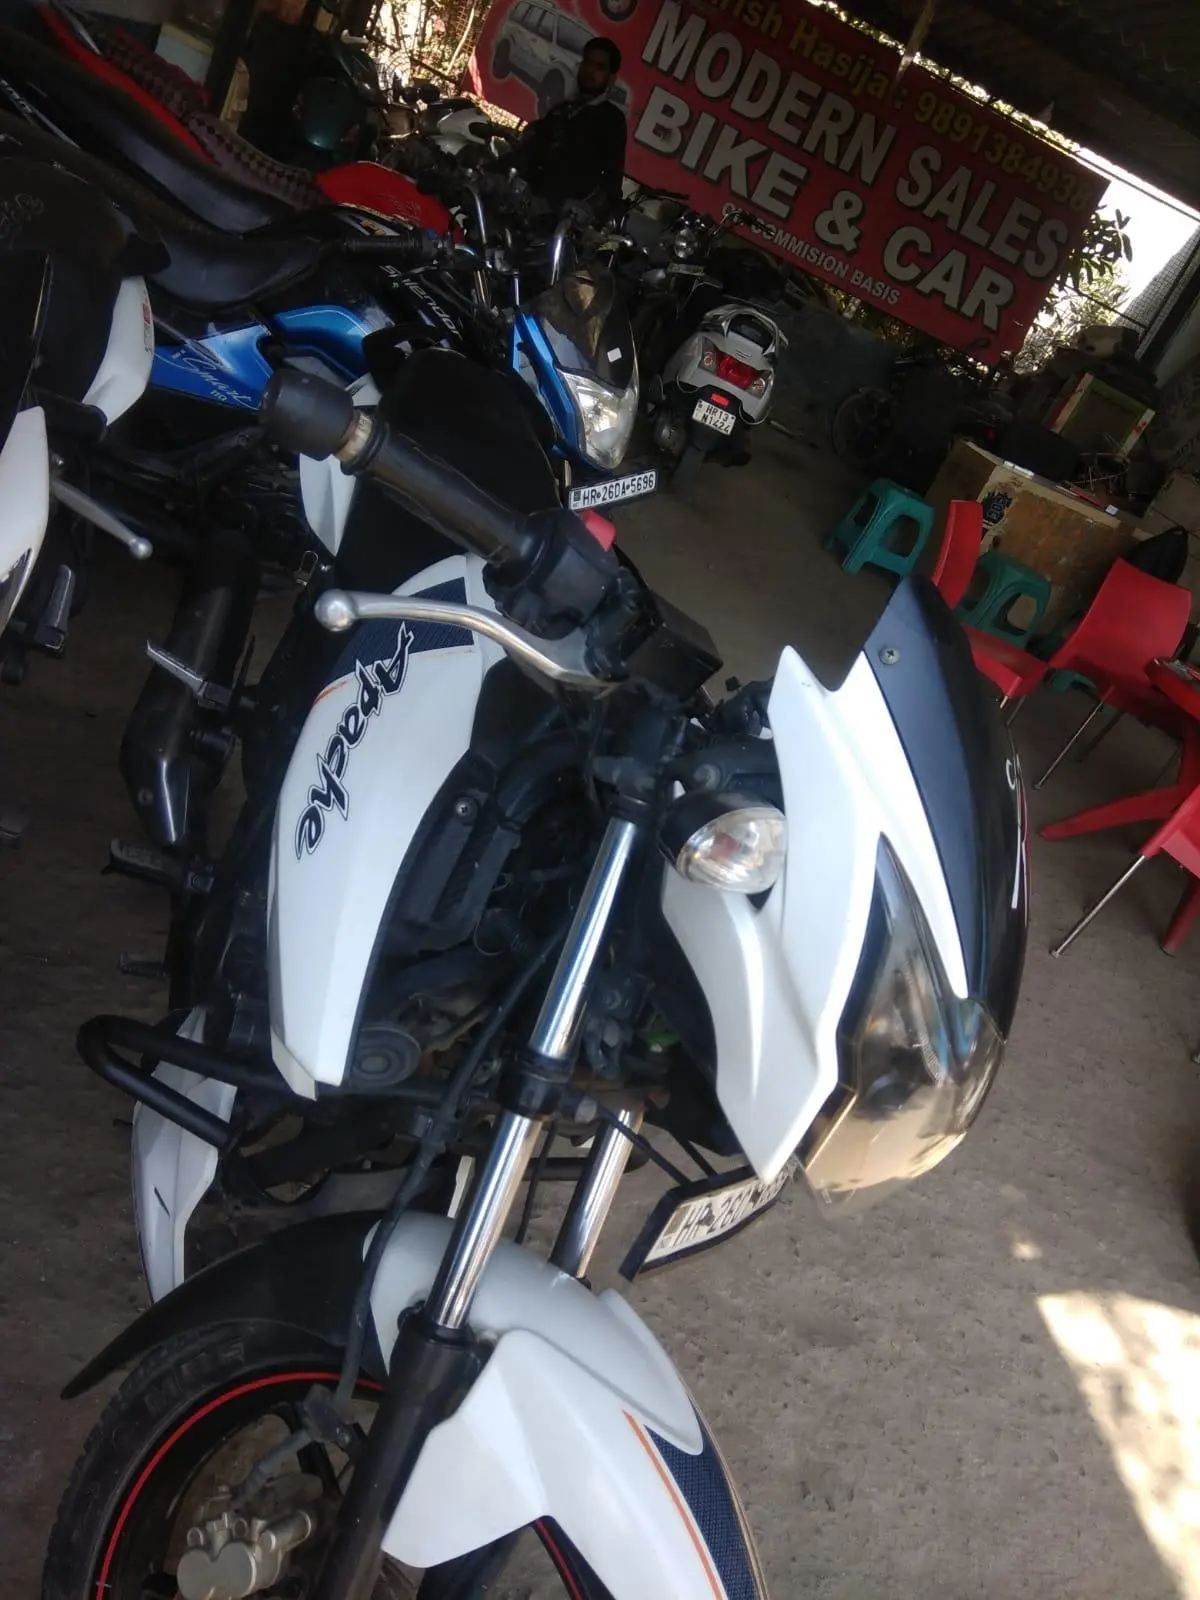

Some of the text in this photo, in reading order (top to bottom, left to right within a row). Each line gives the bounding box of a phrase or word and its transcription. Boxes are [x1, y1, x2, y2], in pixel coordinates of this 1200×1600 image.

[642, 0, 1069, 279] MODERN SALES
[788, 17, 891, 99] Hasija
[634, 86, 1015, 332] BIKE & CAR
[750, 216, 850, 280] COMMISION
[851, 269, 900, 305] BASIS
[706, 403, 730, 422] HR13
[294, 619, 415, 861] Apache
